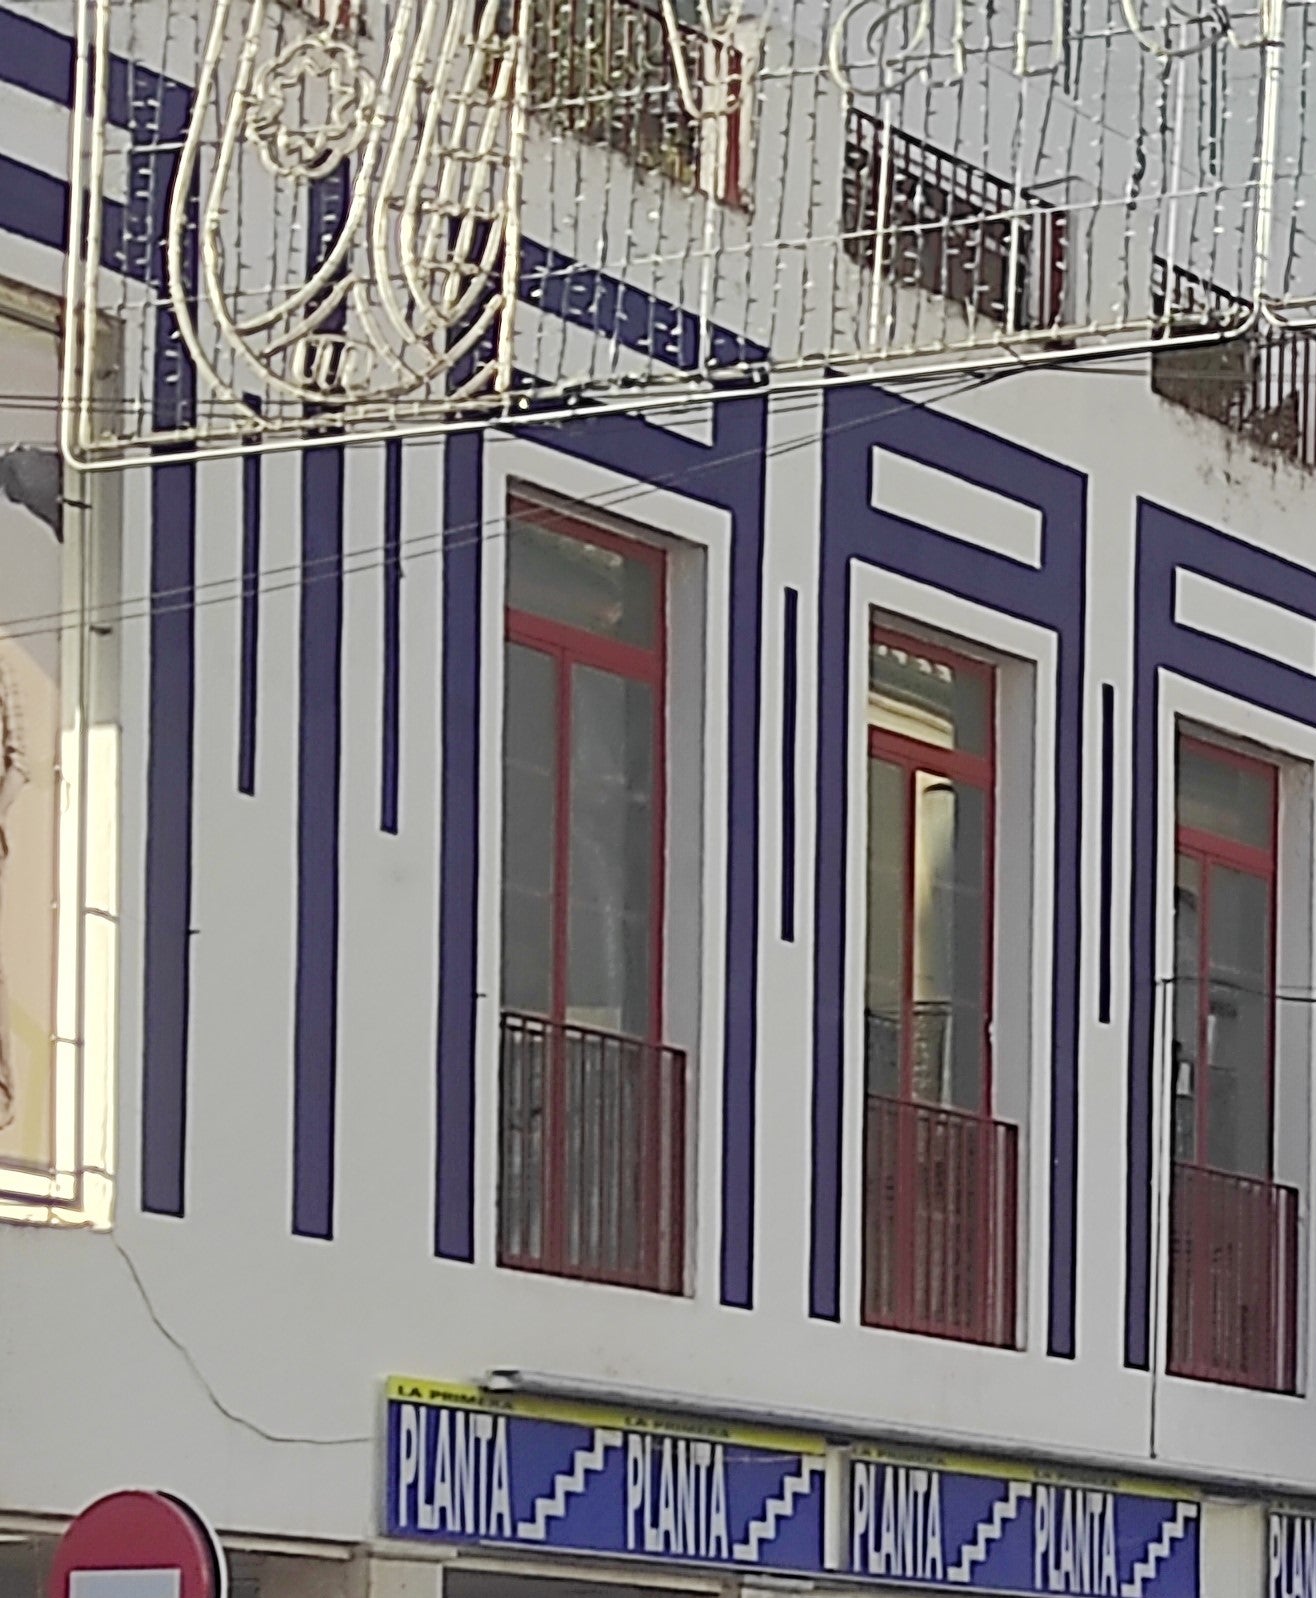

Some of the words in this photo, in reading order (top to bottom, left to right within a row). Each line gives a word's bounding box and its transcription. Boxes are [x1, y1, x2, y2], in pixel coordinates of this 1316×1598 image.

[399, 1403, 513, 1538] PLANTA
[626, 1432, 730, 1560] PLANTA
[853, 1462, 944, 1580] PLANTA
[1034, 1484, 1119, 1598] PLANTA
